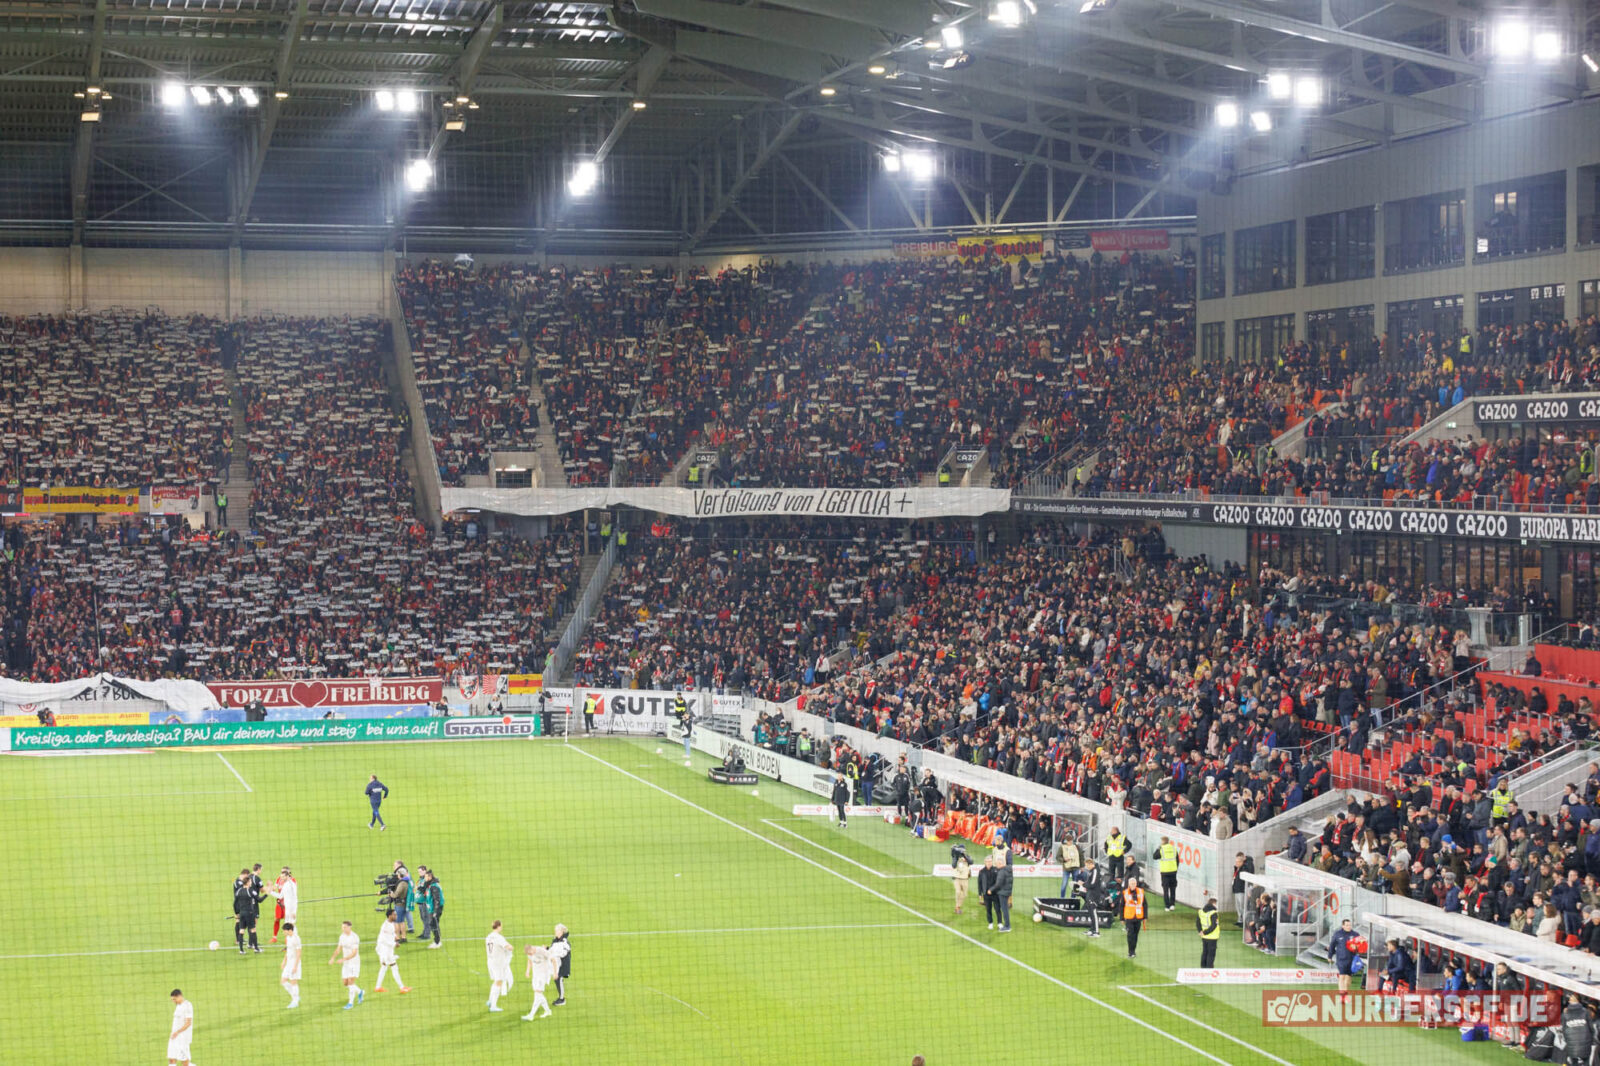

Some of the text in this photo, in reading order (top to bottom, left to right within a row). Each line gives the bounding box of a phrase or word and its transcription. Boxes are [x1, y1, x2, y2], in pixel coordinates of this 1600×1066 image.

[1479, 403, 1517, 420] CAZOO
[1527, 401, 1568, 418] CAZOO
[694, 490, 782, 515] Verfolgung
[784, 493, 813, 512] von
[1213, 505, 1249, 524] CAZOO
[1256, 506, 1294, 526] CAZOO
[1301, 508, 1342, 528] CAZOO
[1349, 510, 1392, 531] CAZOO
[1400, 511, 1448, 533] CAZOO
[1456, 514, 1507, 537] CAZOO
[1520, 517, 1569, 540] EUROPA
[221, 685, 430, 704] FORZA FREIBURG
[15, 731, 72, 747] Kreisliga
[75, 730, 105, 744] oder
[105, 728, 180, 745] Bundesliga?
[183, 727, 211, 742] BAU
[213, 727, 232, 740] dir
[233, 726, 275, 740] deinen
[276, 725, 298, 738] Job
[301, 724, 324, 737] und
[366, 722, 385, 736] bei
[386, 725, 408, 735] uns
[410, 722, 439, 735] auf!
[445, 722, 533, 736] GRAFRIED
[757, 752, 781, 775] BODEN
[1170, 840, 1202, 869] ZOO
